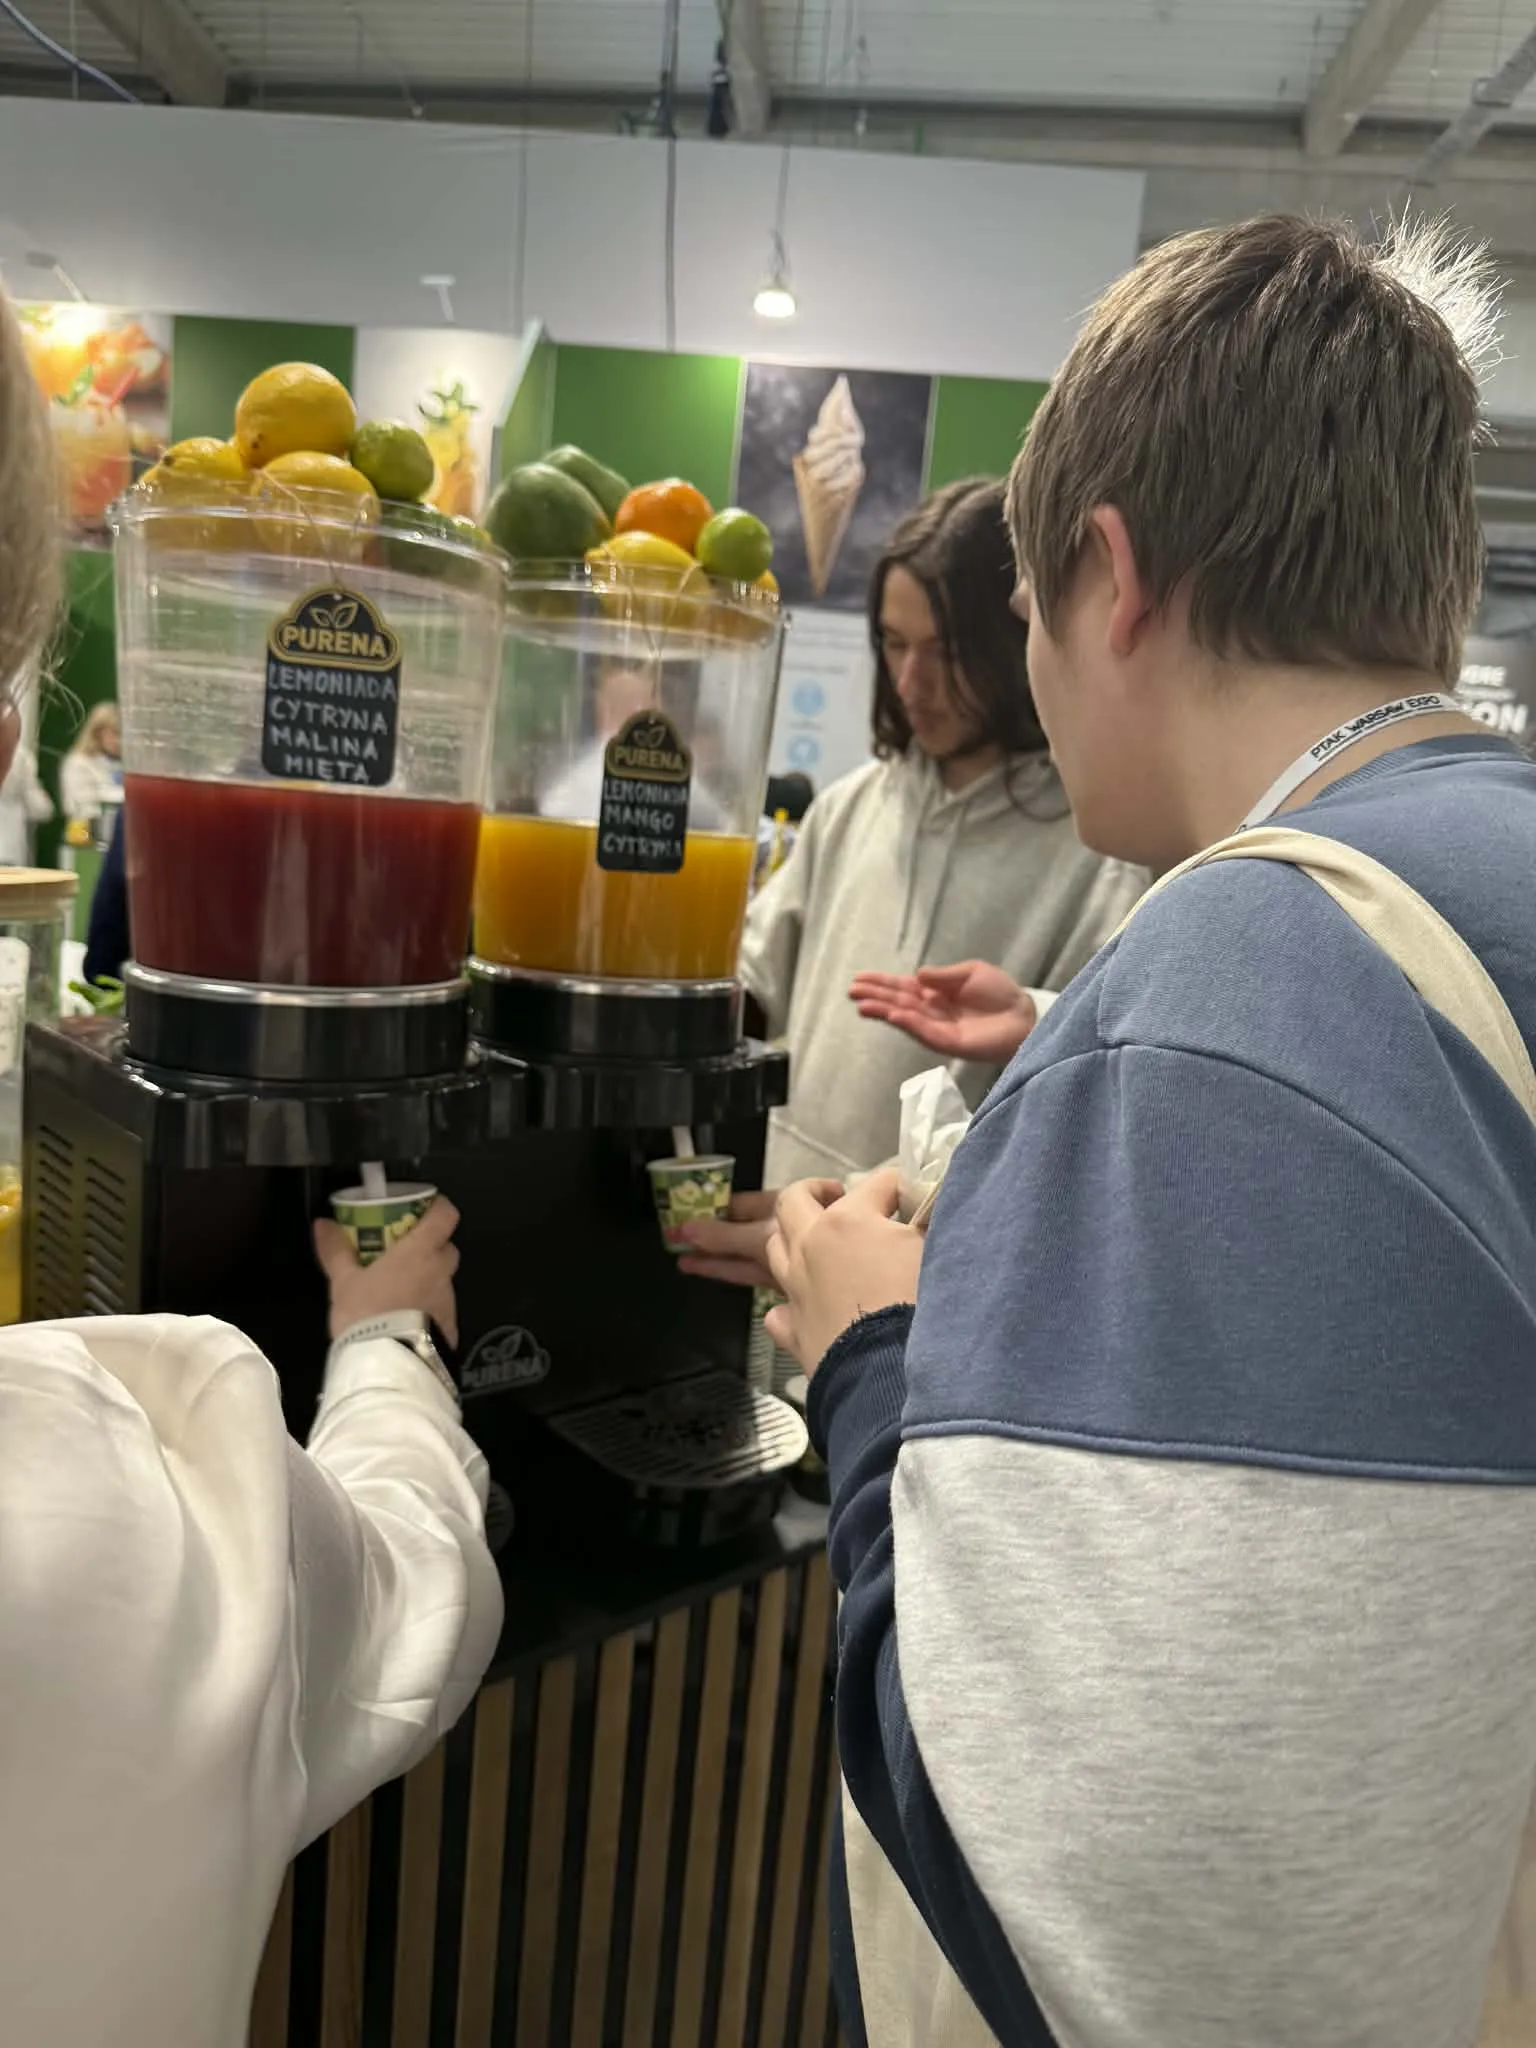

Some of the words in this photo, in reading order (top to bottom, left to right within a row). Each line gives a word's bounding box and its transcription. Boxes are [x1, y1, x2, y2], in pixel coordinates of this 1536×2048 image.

[282, 625, 387, 659] PURENA
[268, 663, 397, 701] LEMONIADA
[269, 695, 388, 736] CYTRYNA
[1310, 731, 1346, 759] PTAK
[1345, 703, 1405, 734] WARSAW
[1407, 694, 1442, 709] EXPO
[270, 725, 379, 761] MALINA
[614, 745, 684, 770] PURENA
[603, 803, 676, 835] MANGO
